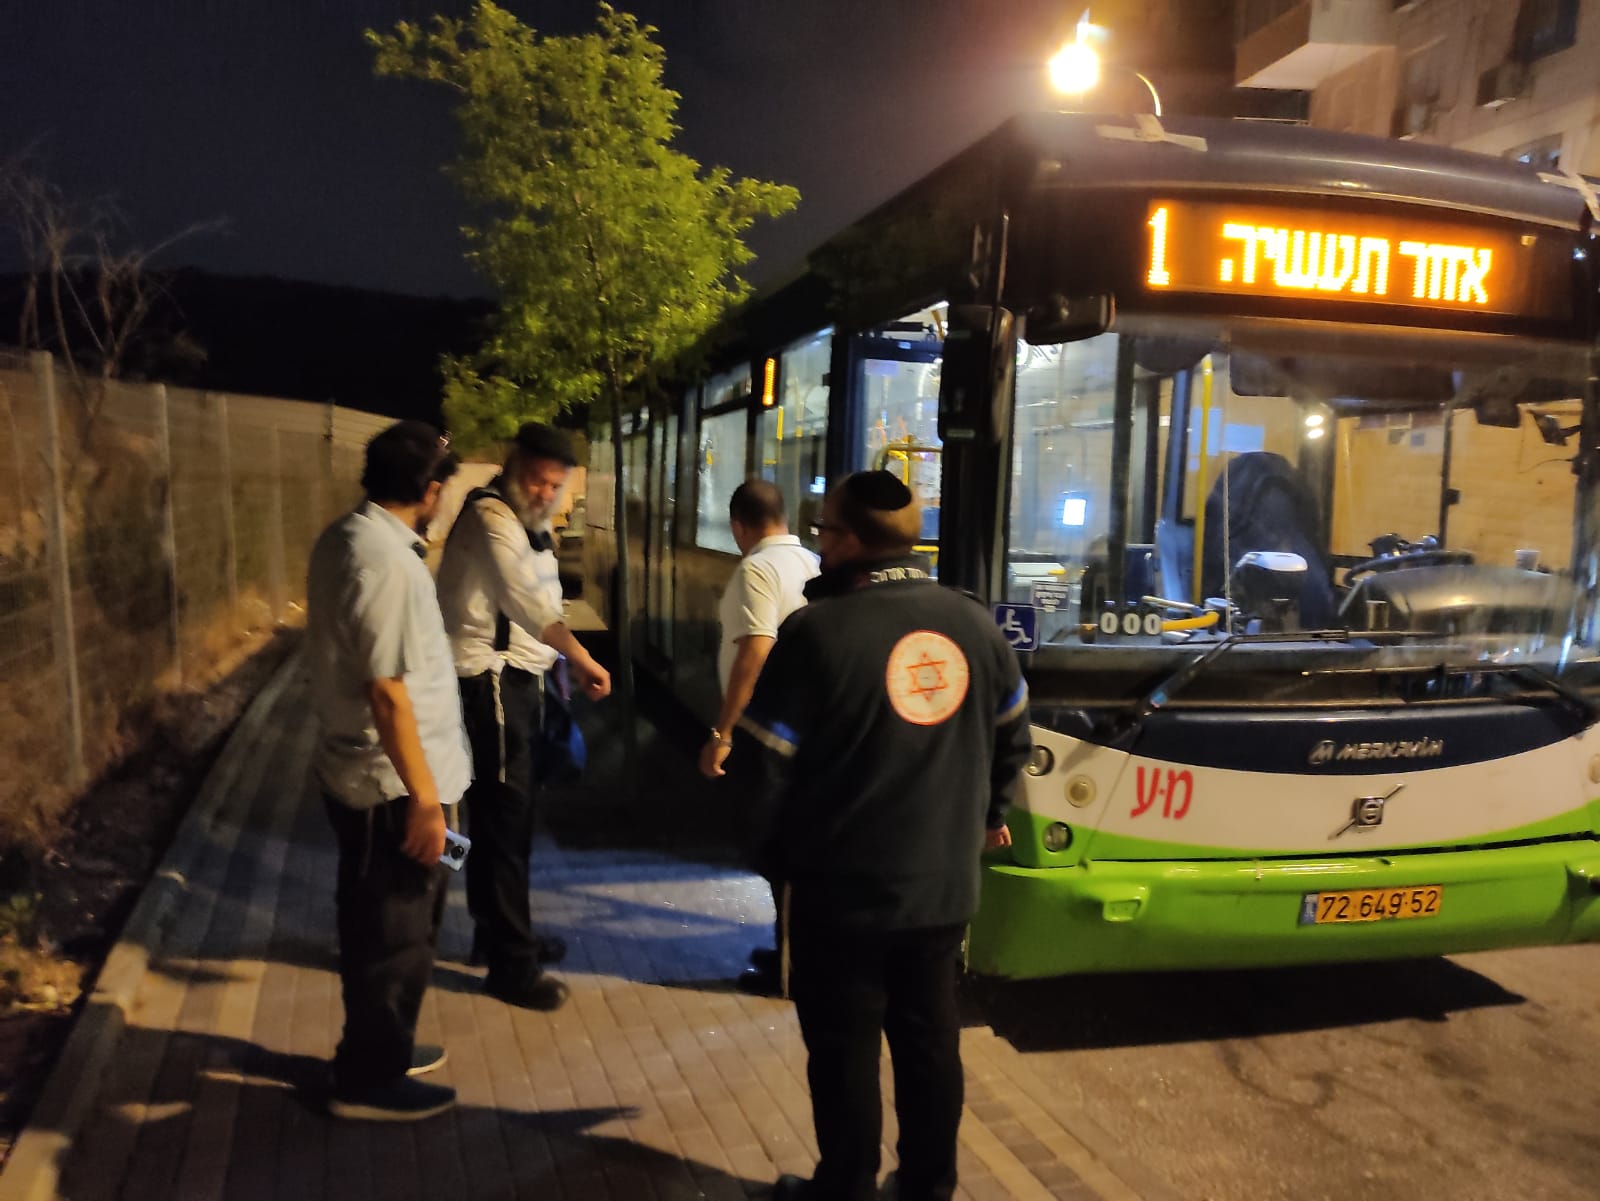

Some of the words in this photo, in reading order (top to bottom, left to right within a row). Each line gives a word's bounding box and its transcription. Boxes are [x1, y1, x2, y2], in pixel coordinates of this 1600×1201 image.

[1148, 207, 1170, 286] 1
[1221, 224, 1389, 295] תעשיה
[1399, 241, 1491, 303] אזור
